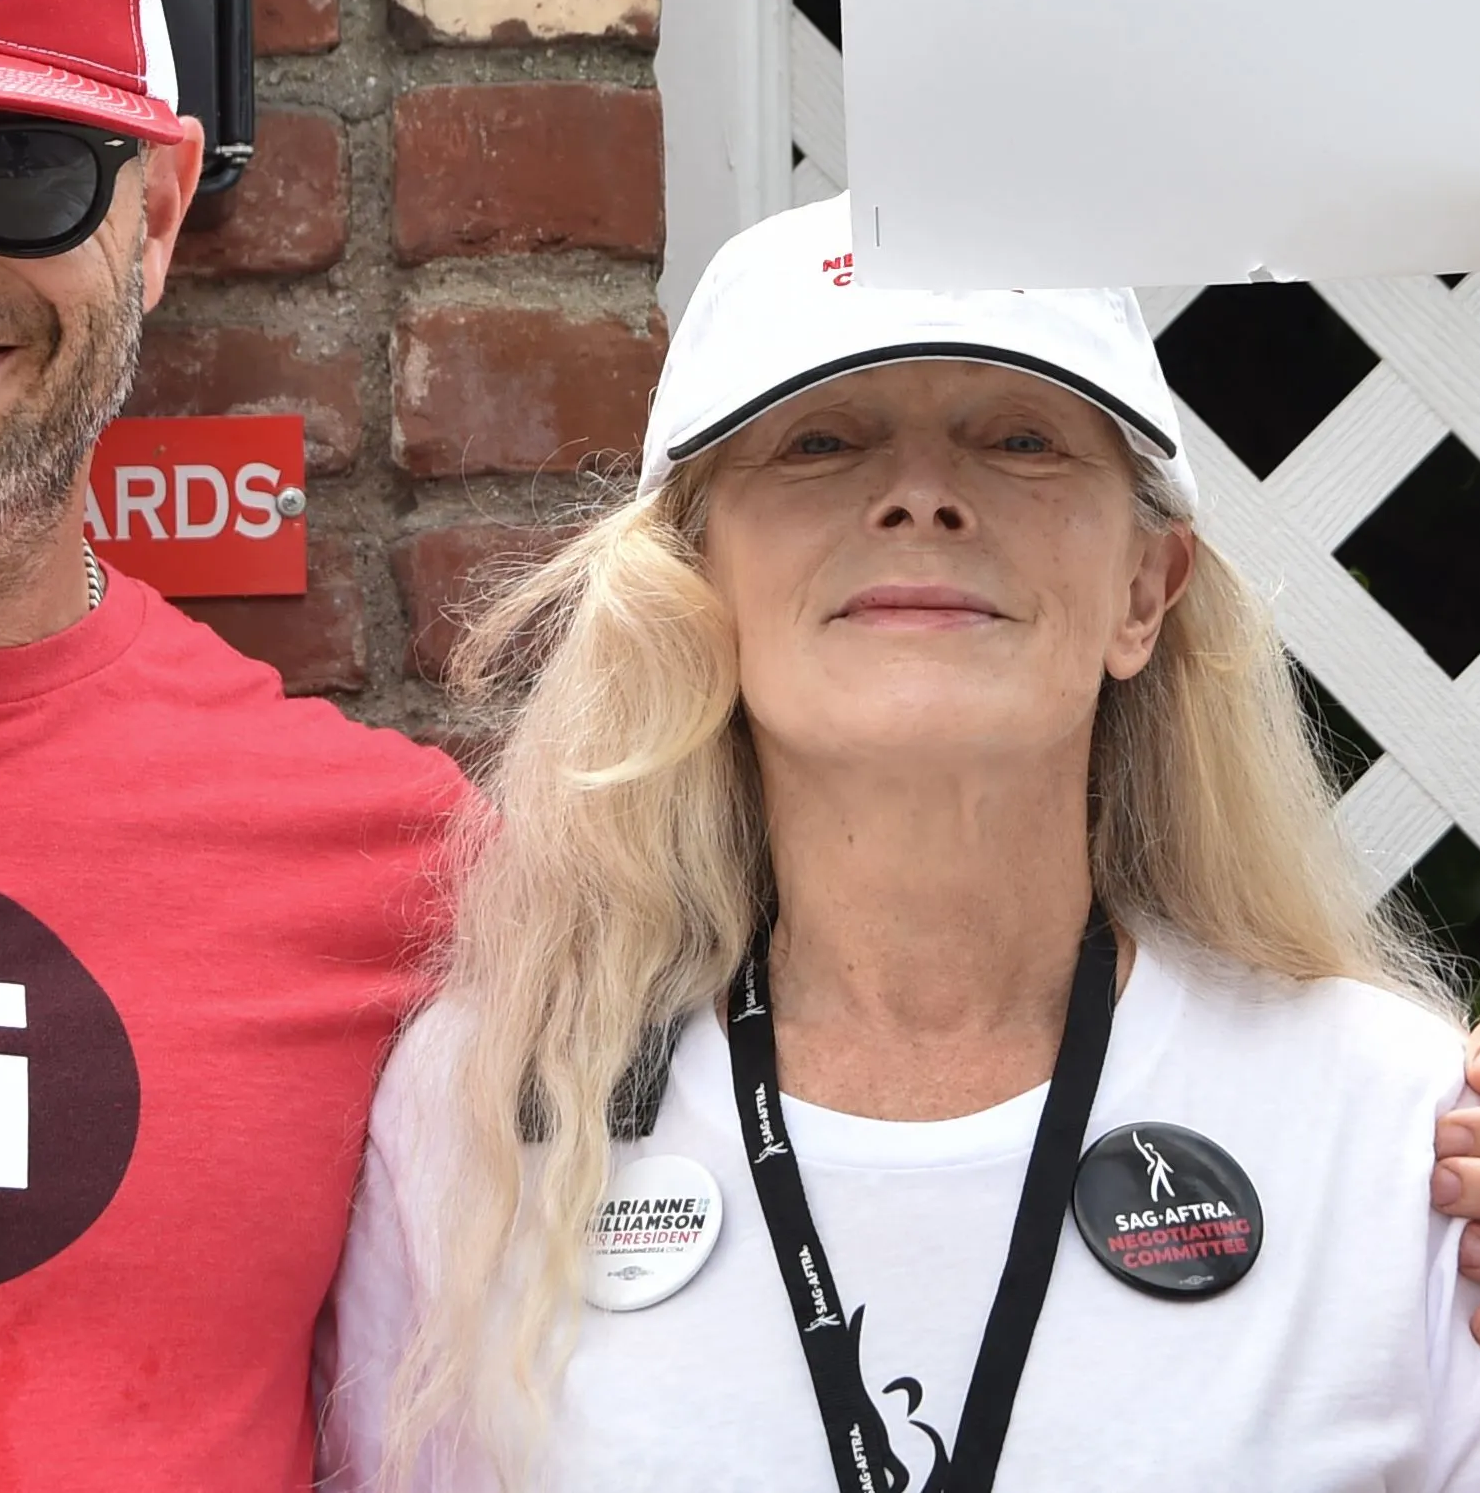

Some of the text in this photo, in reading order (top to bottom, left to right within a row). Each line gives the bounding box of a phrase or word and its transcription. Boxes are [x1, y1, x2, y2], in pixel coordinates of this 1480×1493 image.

[612, 1231, 702, 1246] PRESIDENT
[1107, 1218, 1252, 1253] NEGOTIATING
[1122, 1237, 1249, 1268] COMMITTEE
[849, 1422, 876, 1493] AG·AFTRA
